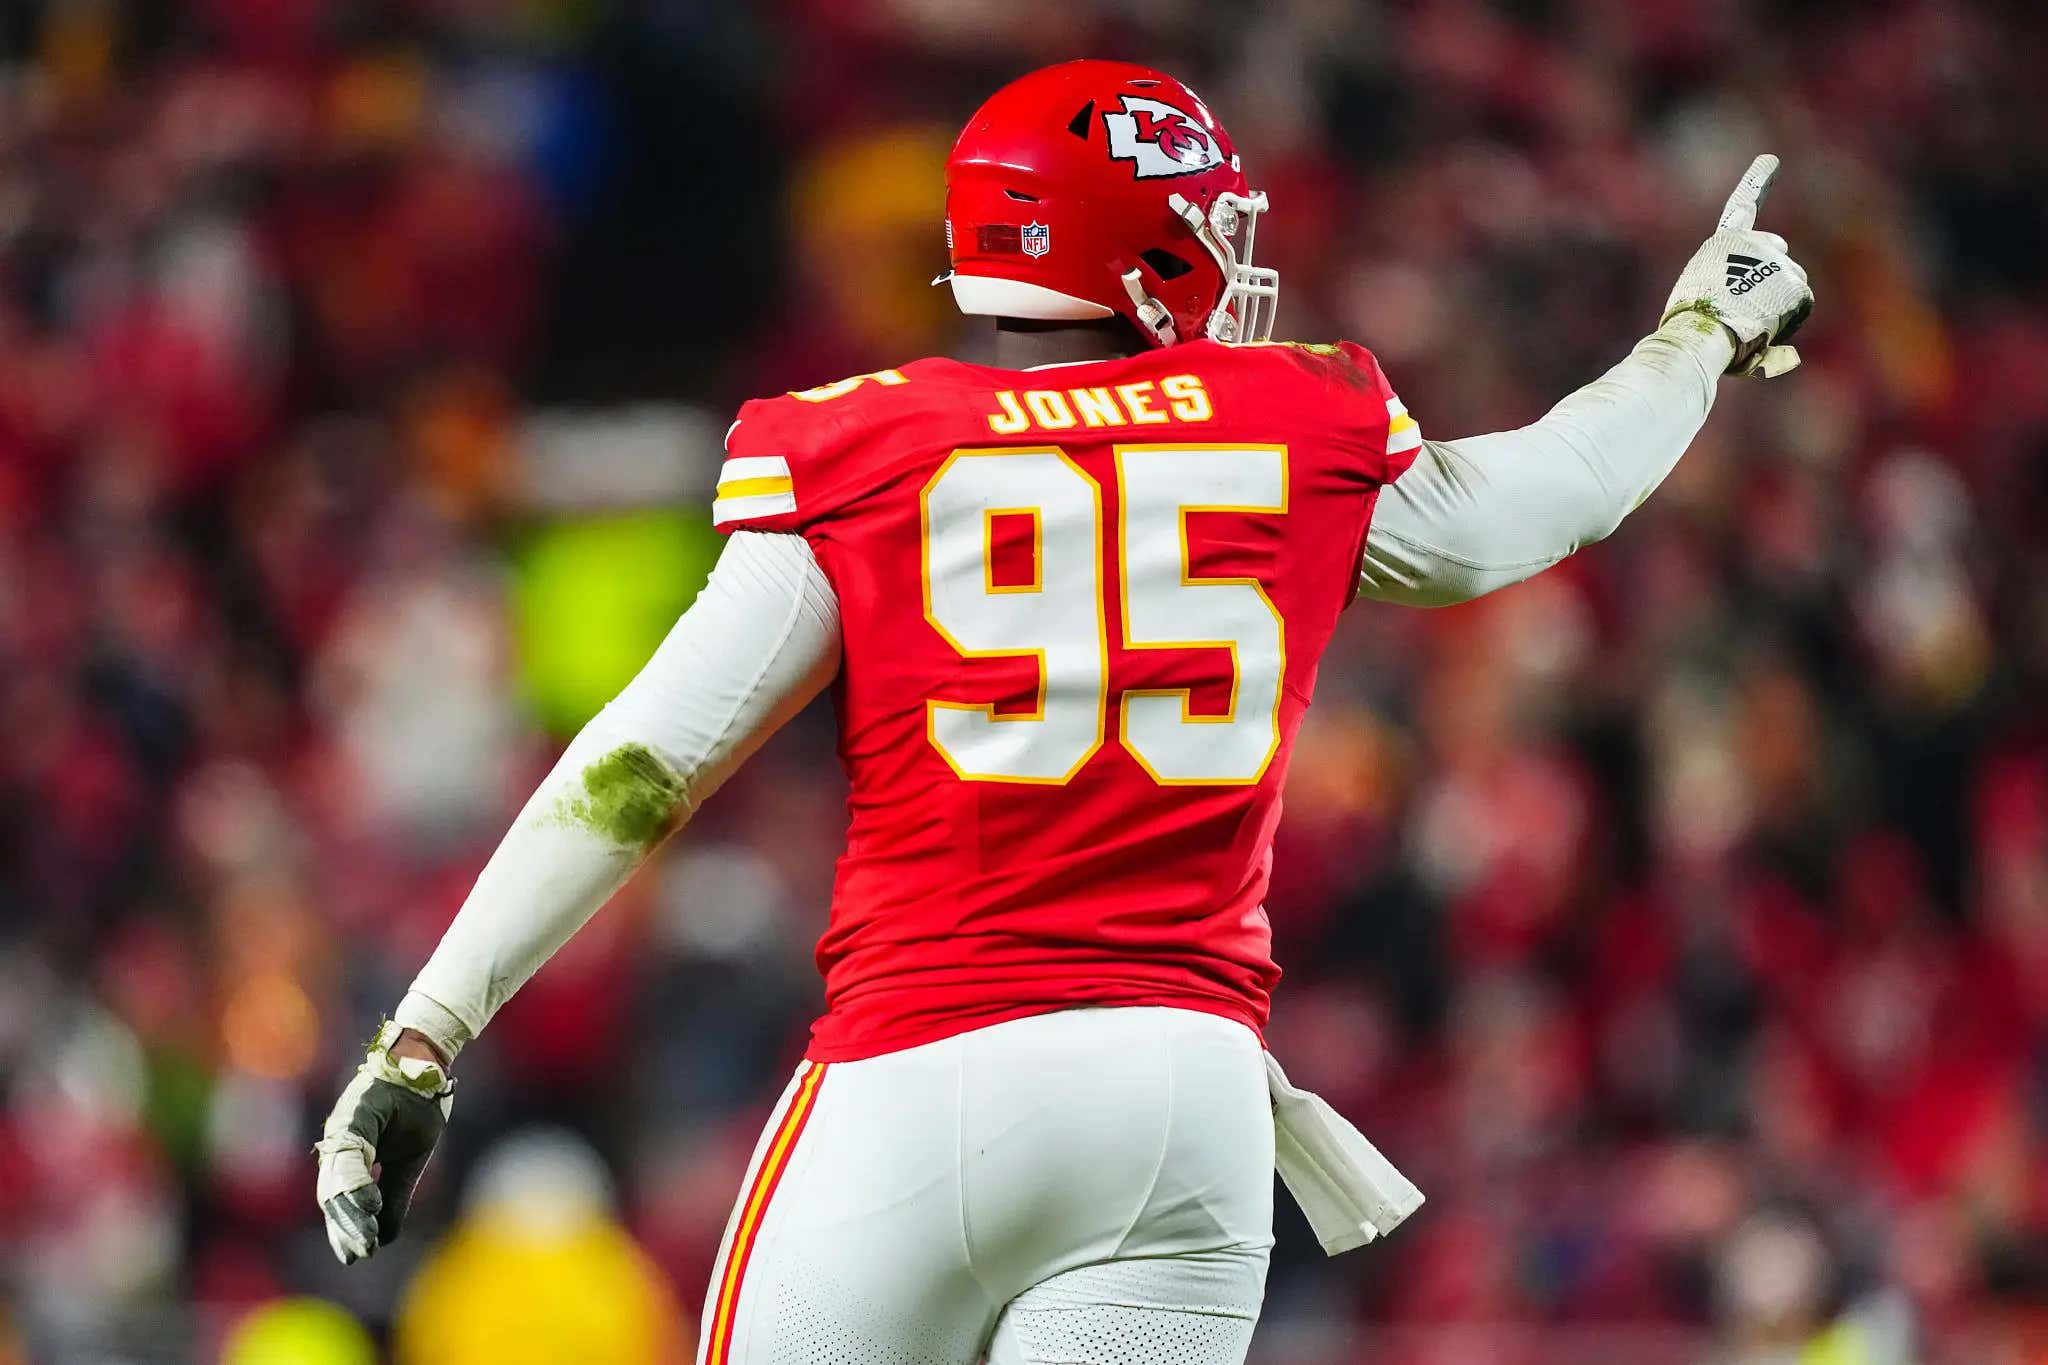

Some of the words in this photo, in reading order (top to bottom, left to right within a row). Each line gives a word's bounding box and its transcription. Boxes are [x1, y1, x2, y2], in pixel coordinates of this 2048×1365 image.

[1129, 110, 1209, 164] KC
[1026, 237, 1046, 251] NFL
[1729, 261, 1781, 296] adidas
[987, 374, 1213, 434] JONES
[919, 443, 1288, 786] 95
